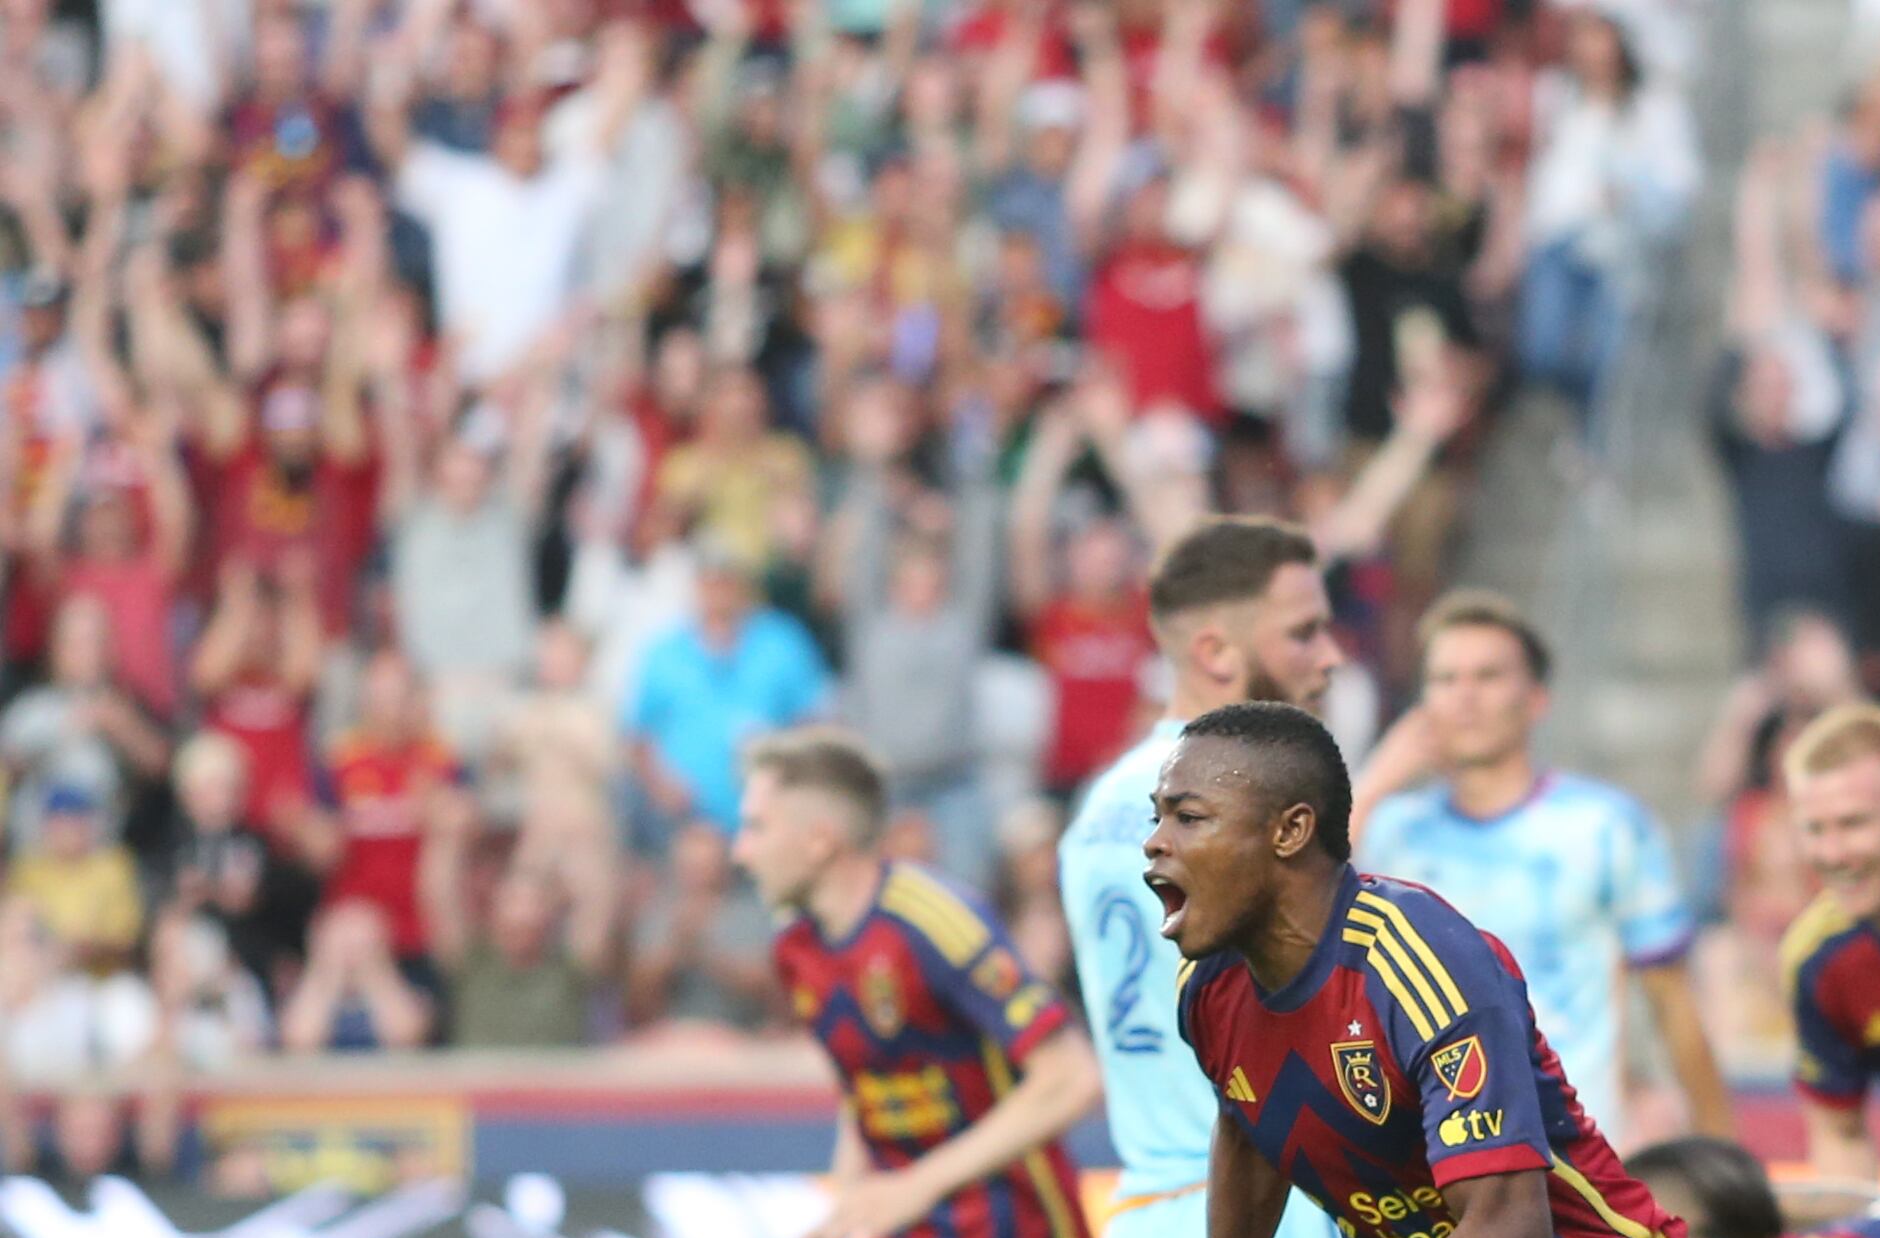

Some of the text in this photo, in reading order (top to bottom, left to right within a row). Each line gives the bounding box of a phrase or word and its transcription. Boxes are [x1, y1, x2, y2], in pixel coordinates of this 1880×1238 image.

[1096, 884, 1165, 1054] 2
[1436, 1048, 1461, 1067] MLS
[1467, 1109, 1503, 1140] tv
[1350, 1186, 1443, 1225] Sele
